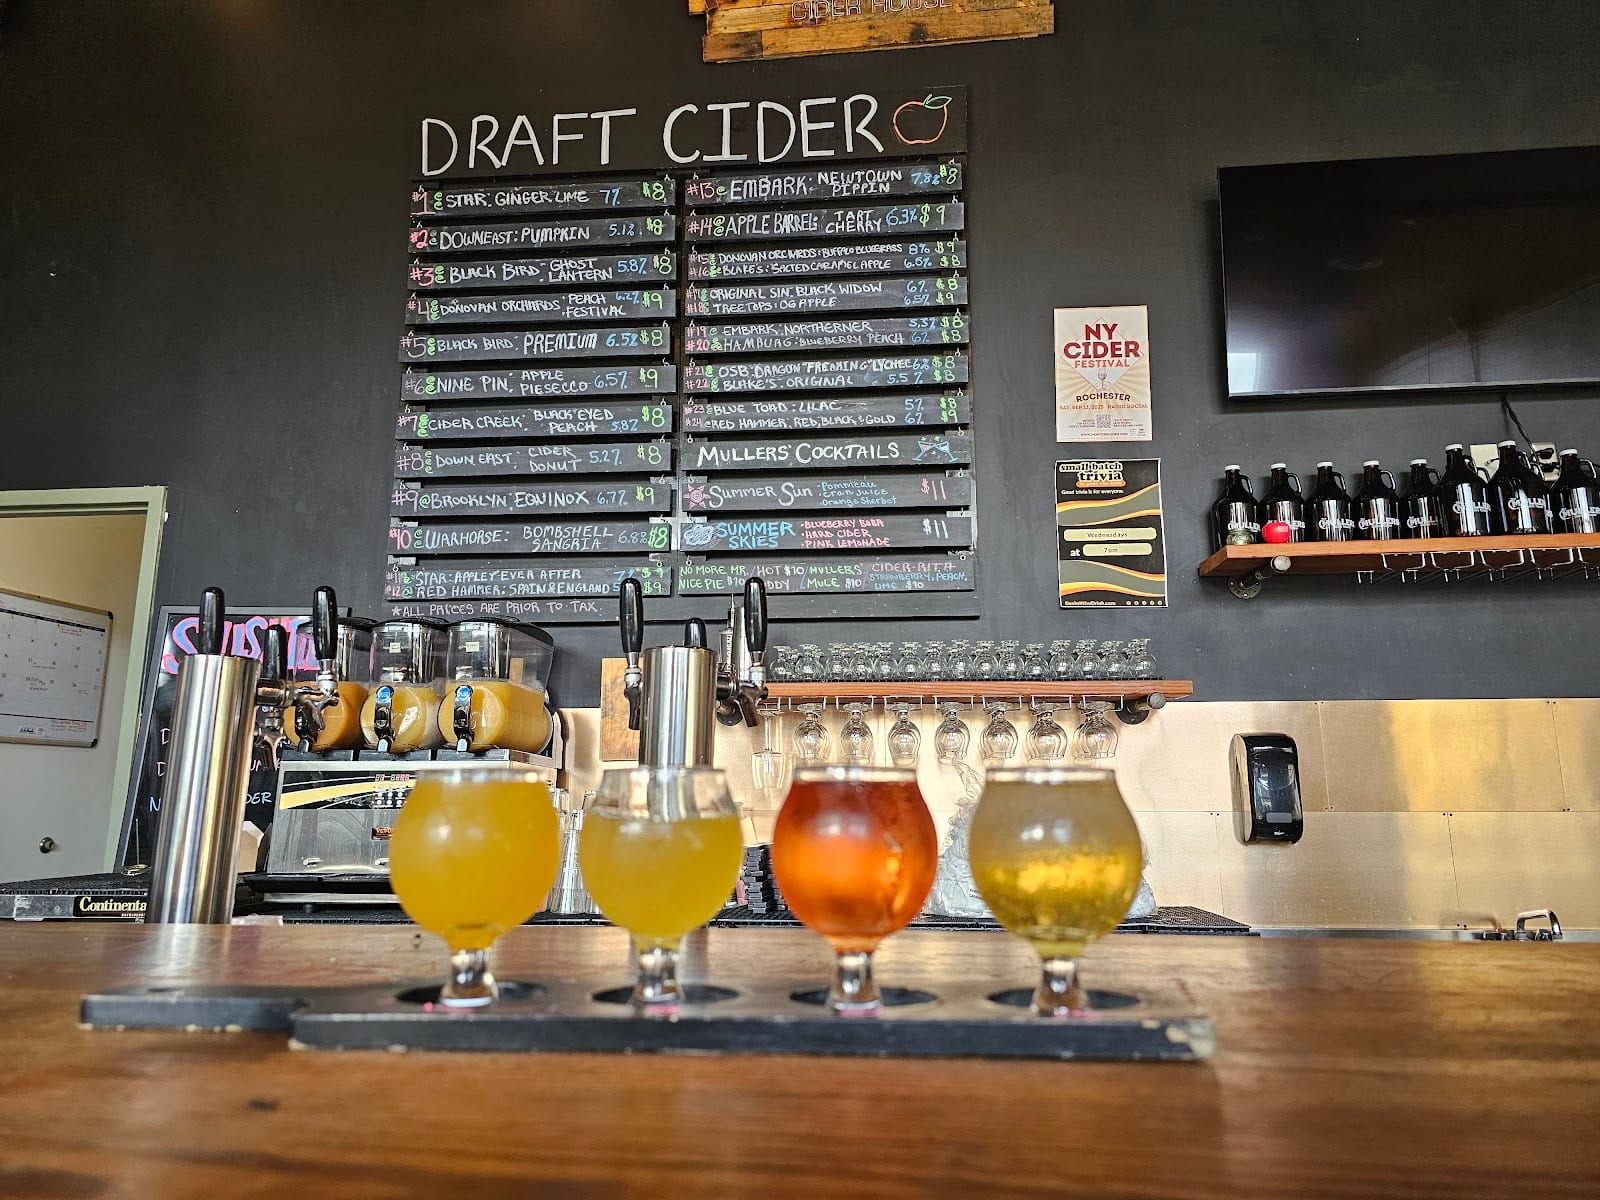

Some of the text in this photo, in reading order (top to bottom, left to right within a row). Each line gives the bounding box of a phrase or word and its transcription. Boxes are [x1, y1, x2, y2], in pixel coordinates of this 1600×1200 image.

[791, 0, 862, 20] CIDER
[421, 93, 885, 176] DRAFT CIDER
[687, 182, 715, 200] #13
[817, 169, 902, 186] NEWTOWN
[940, 164, 958, 185] $8
[832, 182, 890, 196] PIPPIN
[494, 181, 668, 206] GINGER LIME $8
[688, 216, 712, 237] #14
[725, 215, 771, 237] APPLE
[834, 209, 874, 222] TART
[885, 205, 918, 226] 6.3%
[825, 217, 882, 234] CHERRY
[521, 226, 590, 244] PUMPKIN
[646, 217, 664, 236] $8
[718, 243, 930, 265] DONOVAN 8%
[409, 254, 673, 287] #3 BLACK GHOST 5.8% $8
[548, 266, 613, 282] LANTERN
[811, 258, 859, 273] CARAMEL
[860, 258, 892, 270] APPLE
[709, 287, 766, 302] ORIGINAL
[796, 283, 835, 298] BLACK
[839, 282, 882, 295] WIDOW
[408, 291, 663, 322] #4 DONOVAN PEACH $9
[565, 305, 627, 318] FESTIVAL
[798, 296, 838, 310] APPLE
[784, 320, 874, 336] NORTHERNER
[1085, 323, 1119, 341] NY
[400, 336, 428, 358] #5
[437, 337, 478, 352] BLACK
[523, 333, 598, 355] PREMIUM
[639, 329, 664, 348] $8
[1063, 340, 1141, 360] CIDER
[754, 363, 801, 379] DRAGON
[1074, 359, 1131, 370] FESTIVAL
[404, 378, 425, 396] #6
[437, 376, 475, 394] NINE
[521, 369, 564, 381] APPLE
[638, 368, 660, 390] $9
[786, 376, 853, 389] ORIGINAL
[1076, 392, 1131, 403] ROCHESTER
[713, 404, 747, 416] BLUE
[798, 400, 842, 412] LILAC
[939, 397, 958, 410] $8
[428, 414, 475, 431] CIDER
[641, 405, 666, 428] $8
[711, 418, 735, 430] RED
[940, 409, 958, 424] $9
[548, 421, 598, 434] PEACH
[396, 451, 425, 472] #8
[435, 451, 475, 468] DOWN
[528, 446, 578, 459] CIDER
[637, 444, 663, 465] $8
[795, 441, 900, 464] COCKTAILS
[528, 458, 583, 473] DONUT
[1060, 461, 1122, 472] small batch
[1079, 471, 1122, 481] trivia
[921, 477, 947, 500] $11
[391, 489, 420, 513] #9
[635, 486, 656, 505] $9
[716, 518, 949, 539] SUMMER BLUEBERRY BOBA $11
[388, 527, 412, 550] #10
[522, 525, 613, 539] BOMBSHELL
[617, 529, 648, 544] 6.8%
[647, 526, 668, 549] $8
[531, 537, 602, 552] SANGRIA
[728, 528, 872, 549] SKIES HARD CIDER
[804, 537, 891, 549] PINK LEMONADE
[1070, 548, 1081, 557] at
[540, 568, 581, 580] AFTER
[680, 565, 694, 577] NO
[696, 566, 728, 576] MORE
[757, 564, 783, 577] HOT
[415, 586, 447, 599] RED
[679, 578, 704, 590] NICE
[704, 578, 726, 590] PIE
[807, 578, 840, 589] MULE
[480, 602, 500, 615] ARE
[506, 601, 541, 616] PRIOR
[546, 601, 563, 614] TO
[80, 896, 147, 911] Continenta
